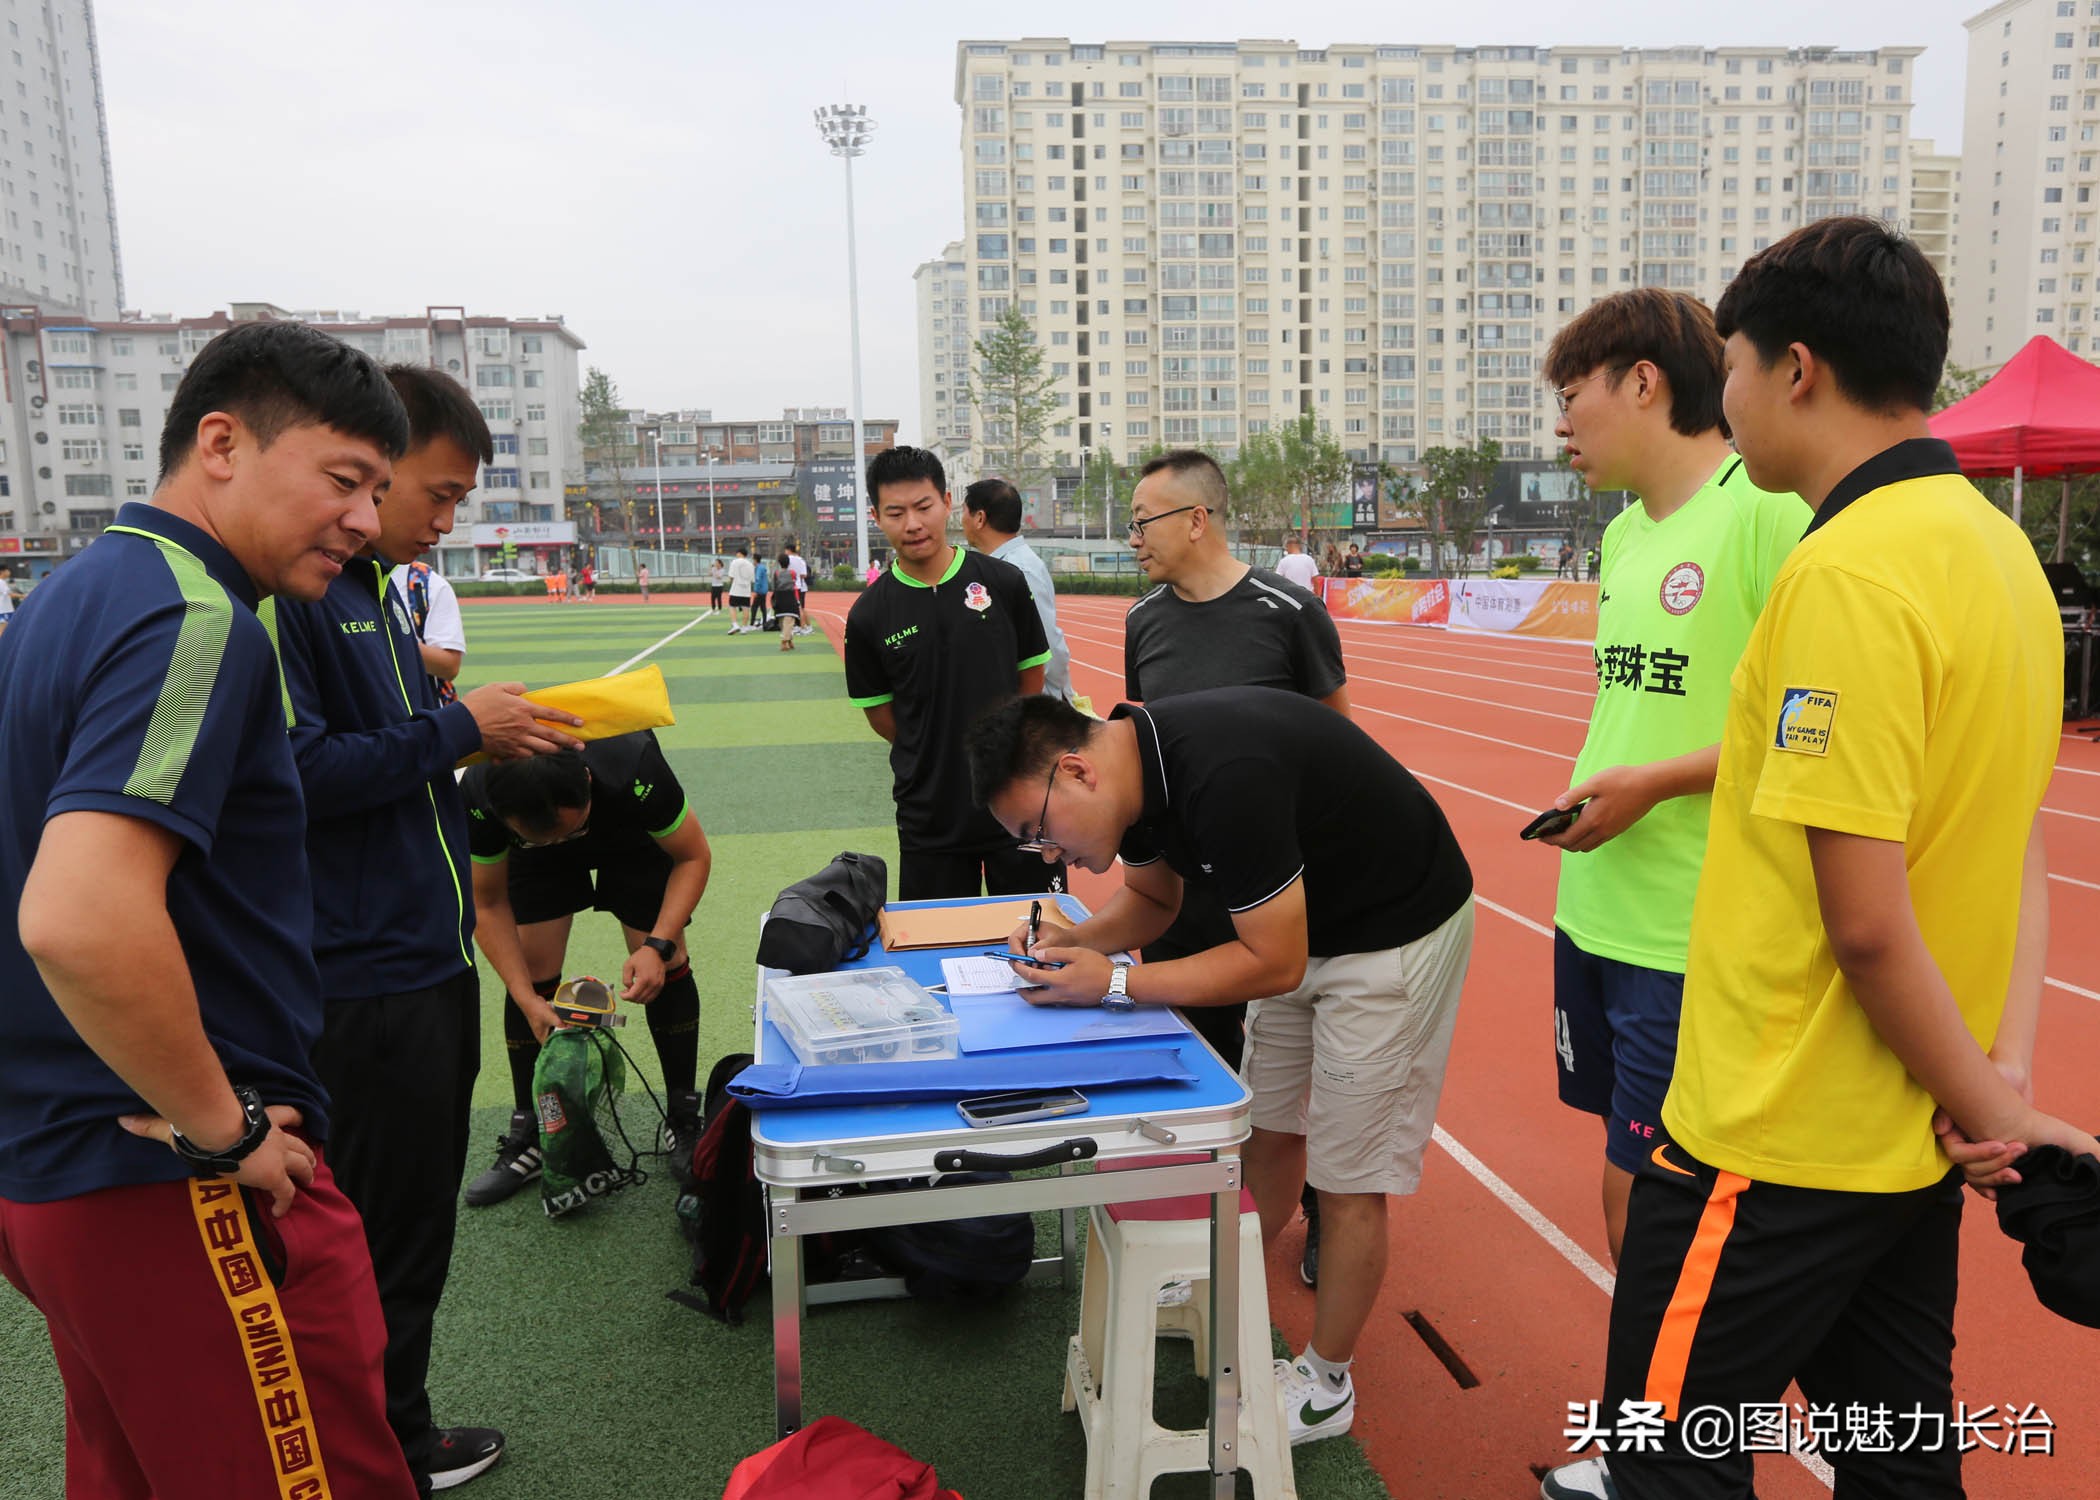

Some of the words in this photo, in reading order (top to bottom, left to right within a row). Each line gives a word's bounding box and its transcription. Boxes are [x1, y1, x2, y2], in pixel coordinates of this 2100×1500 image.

[340, 621, 376, 634] KELME
[884, 625, 919, 646] KELME
[1807, 696, 1832, 708] FIFA
[1797, 727, 1816, 735] GAME
[1802, 735, 1825, 744] PLAY
[204, 1208, 263, 1297] 中国
[240, 1302, 291, 1388] CHINA
[264, 1388, 313, 1475] 中国
